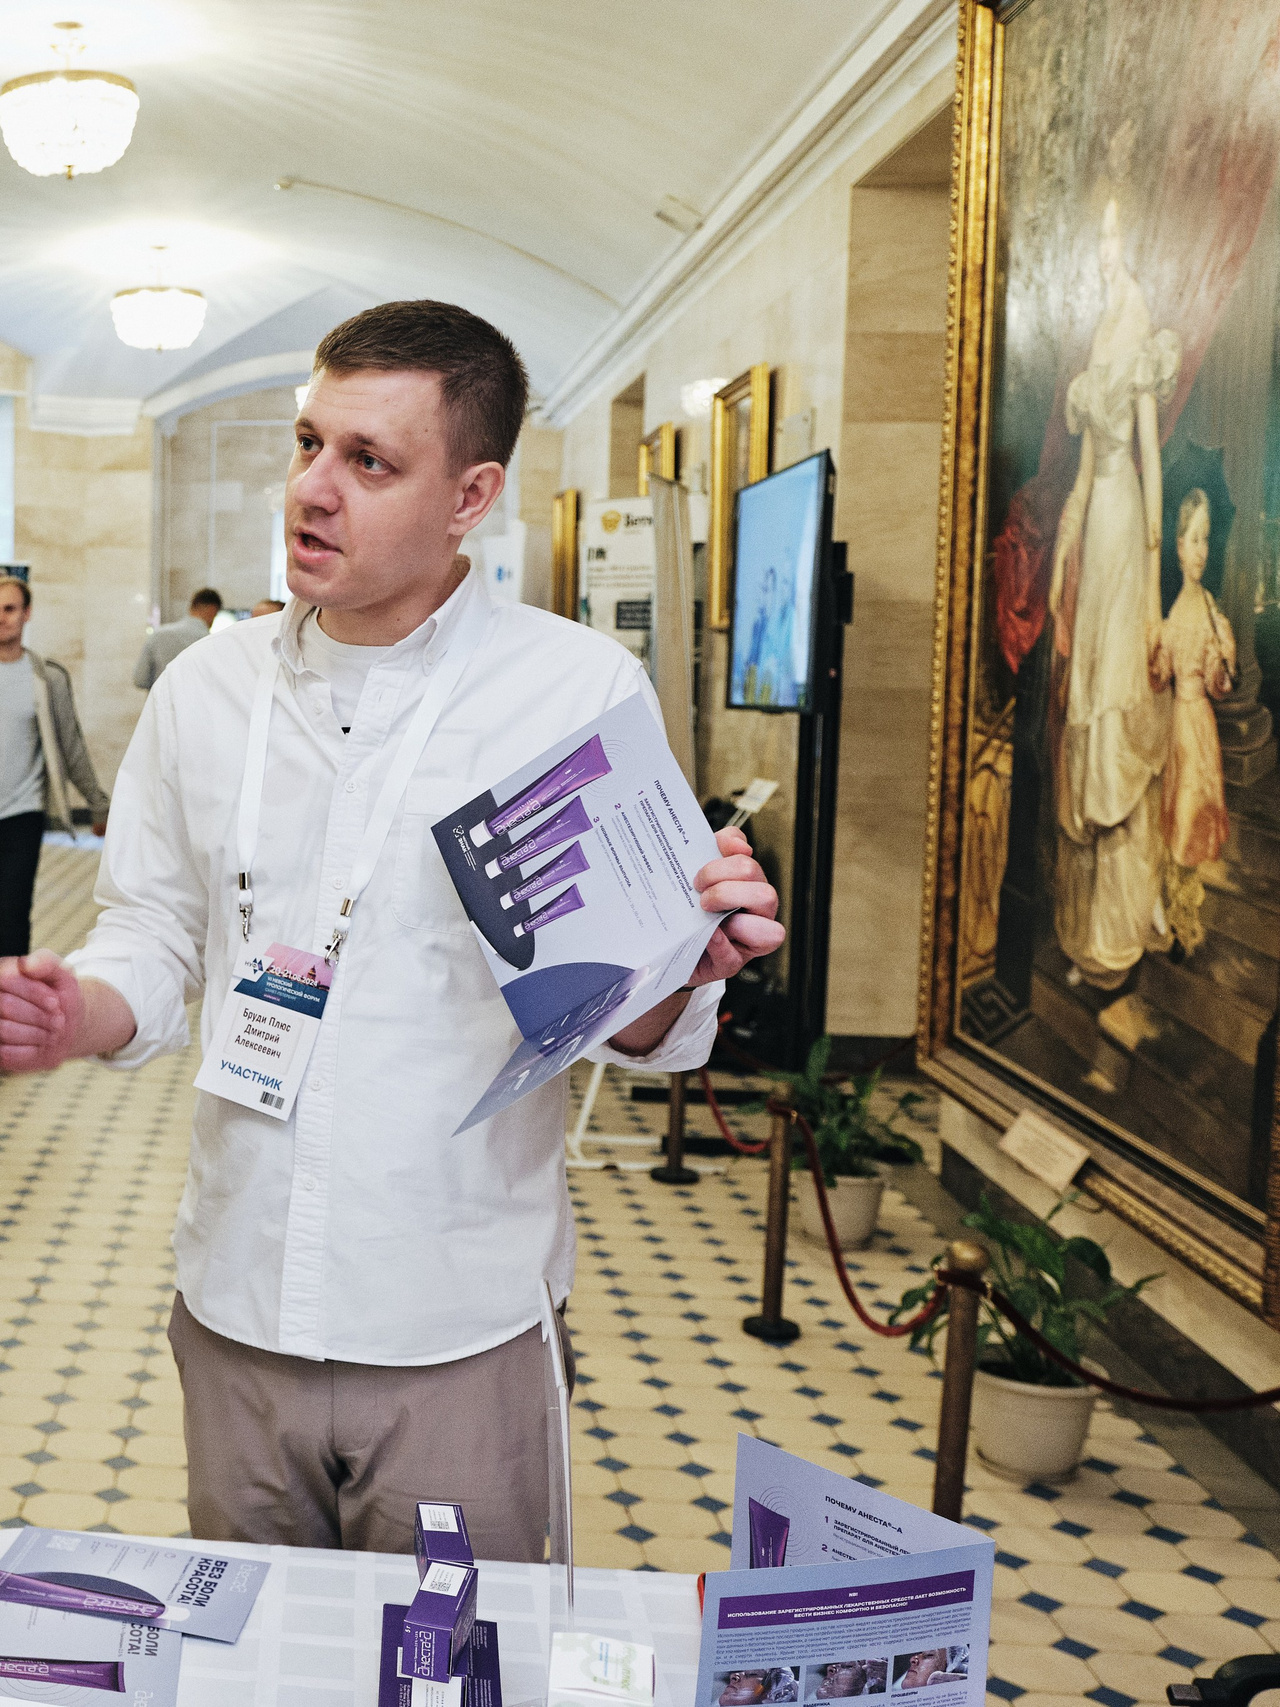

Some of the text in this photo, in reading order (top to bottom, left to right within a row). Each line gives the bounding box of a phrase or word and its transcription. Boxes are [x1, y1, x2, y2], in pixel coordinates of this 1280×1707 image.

[652, 778, 671, 808] ПОЧЕМУ
[613, 801, 622, 810] 2
[592, 815, 600, 823] 3
[243, 1008, 291, 1032] Бруди Плюс
[244, 1023, 280, 1044] Дмитрий
[235, 1035, 281, 1059] Алексеевич
[220, 1059, 283, 1091] УЧАСТНИК
[825, 1496, 856, 1513] ПОЧЕМУ
[834, 1520, 898, 1551] ЗАРЕГИСТРИРОВАННЫЙ
[834, 1525, 861, 1540] ПРЕПАРАТ
[862, 1538, 873, 1546] ДЛЯ
[822, 1544, 828, 1552] 2
[176, 1558, 213, 1606] КРАСОТА!
[199, 1560, 228, 1608] БЕЗ БОЛИ
[727, 1610, 777, 1618] ИСПОЛЬЗОВАНИЕ
[778, 1604, 843, 1614] ЗАРЕГИСТРИРОВАННЫХ
[844, 1599, 890, 1608] ЛЕКАРСТВЕННЫХ
[929, 1587, 966, 1597] ВОЗМОЖНОСТЬ
